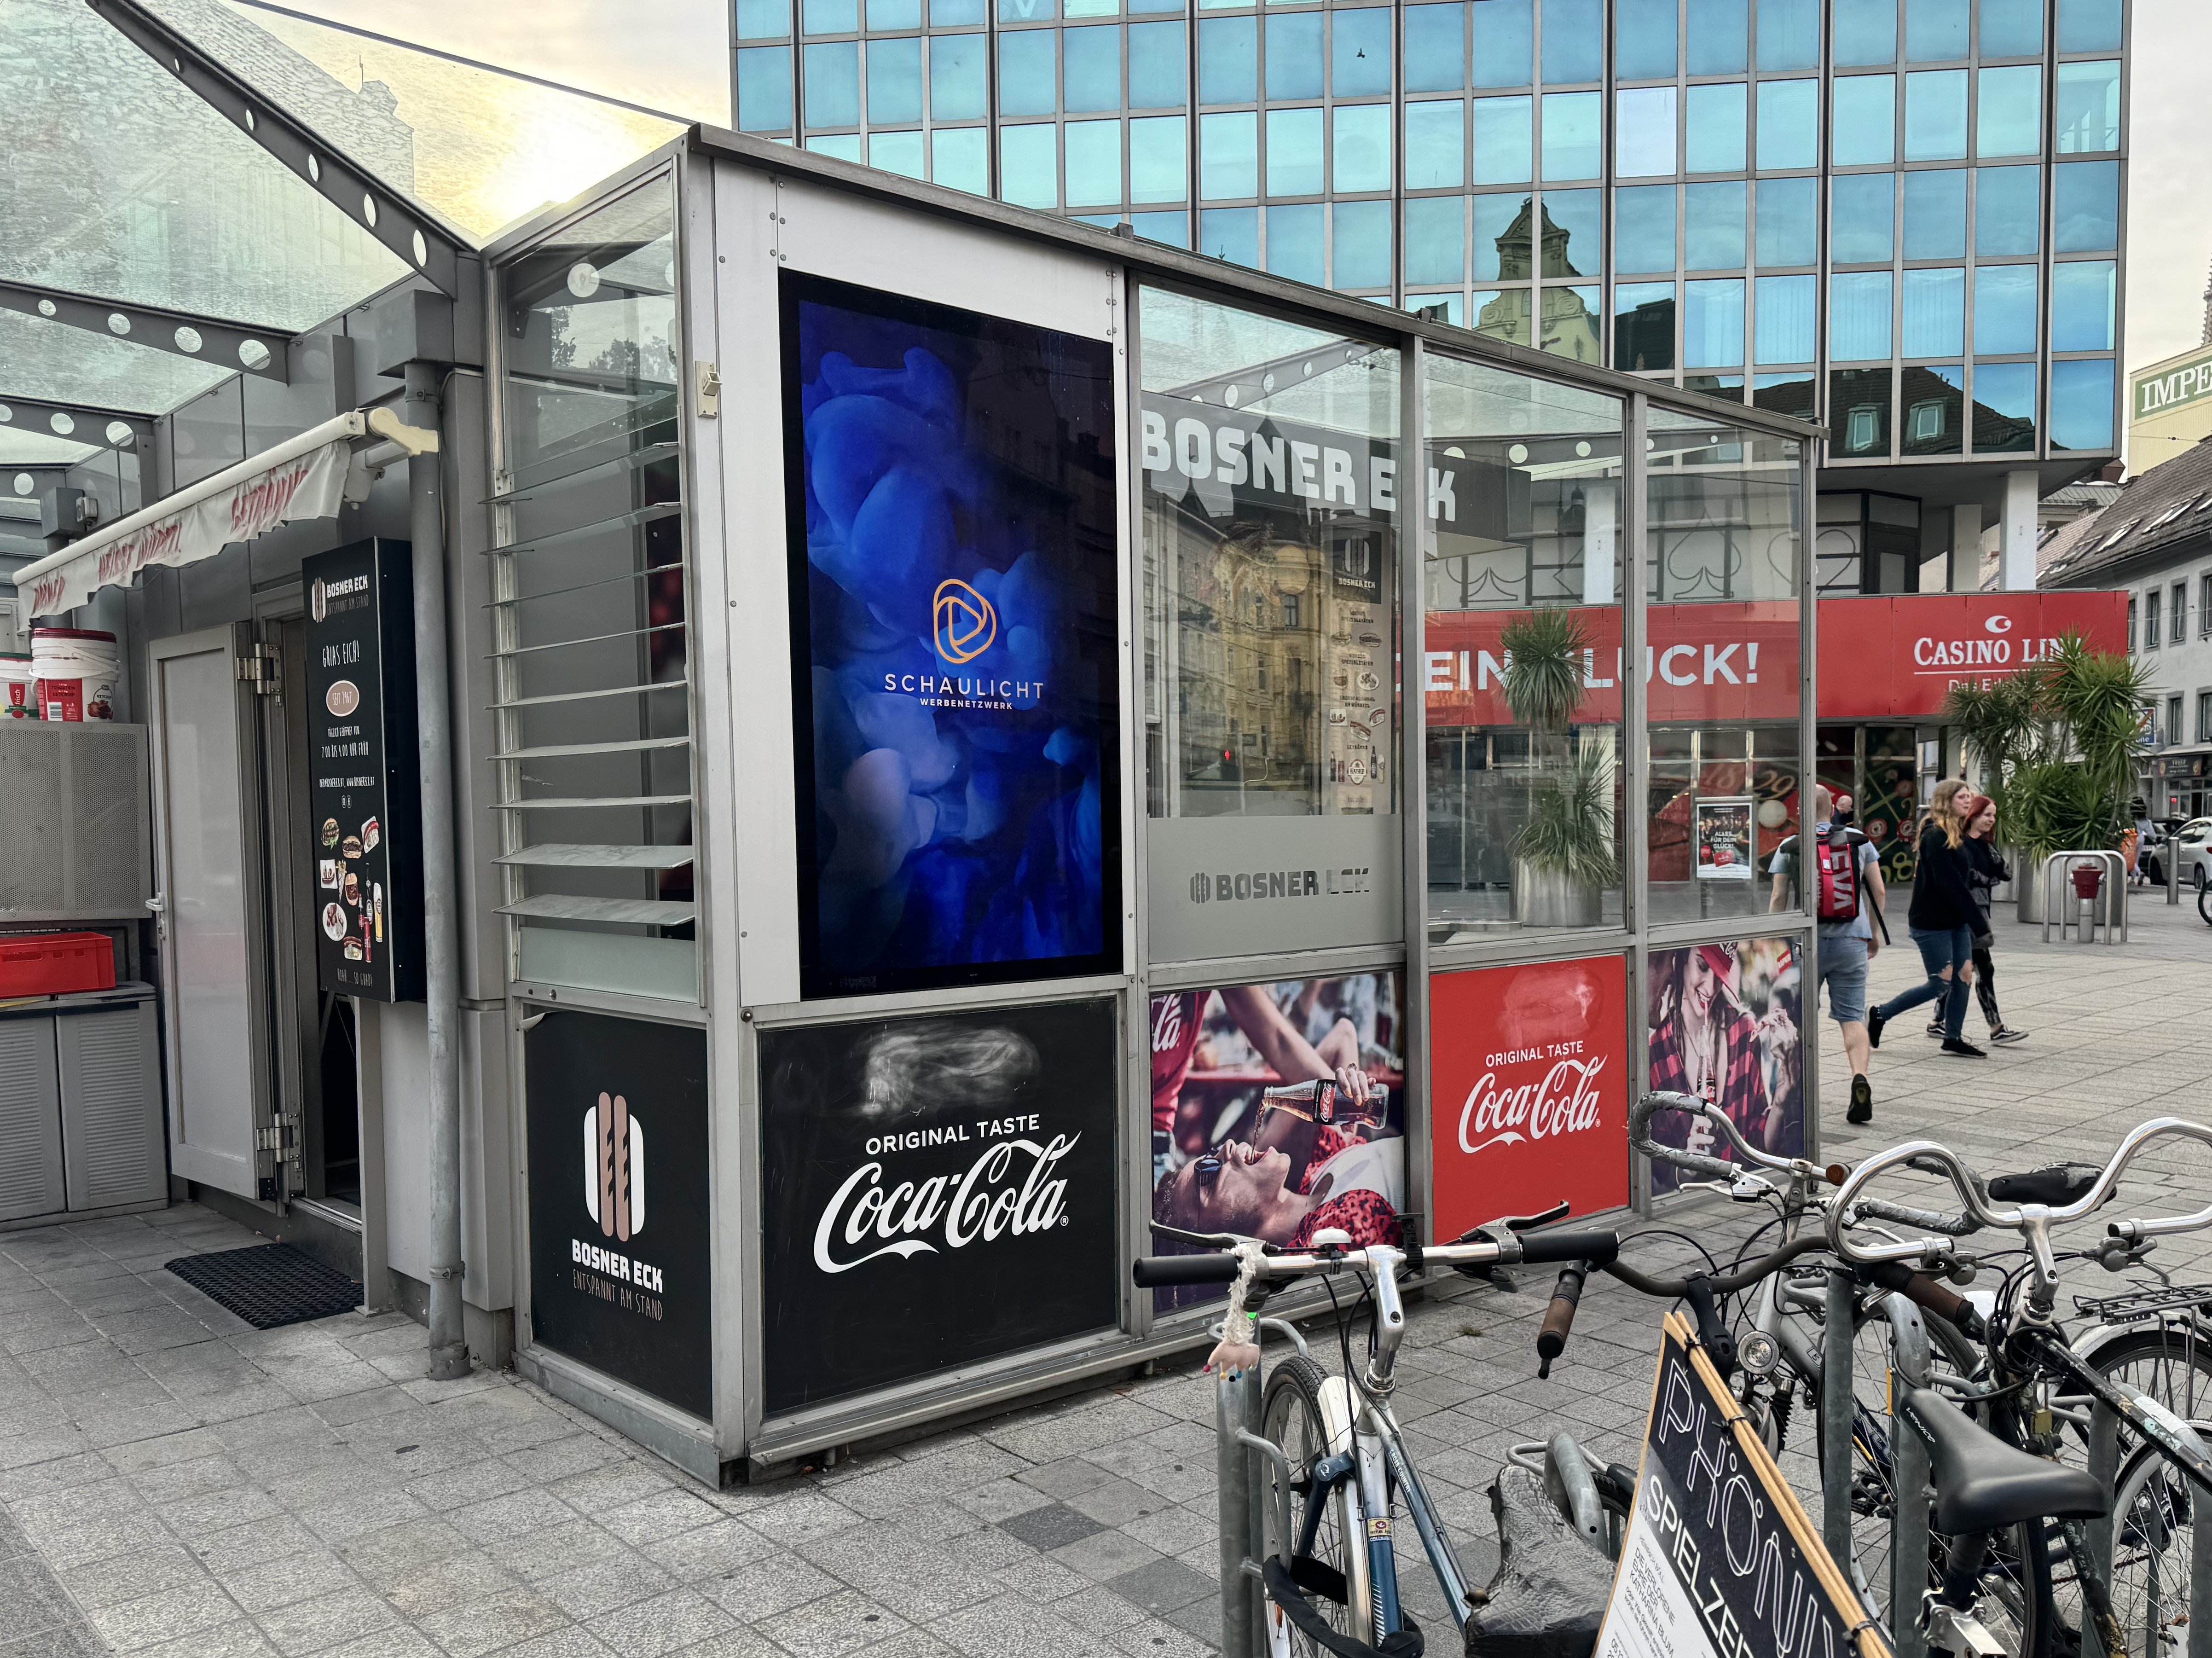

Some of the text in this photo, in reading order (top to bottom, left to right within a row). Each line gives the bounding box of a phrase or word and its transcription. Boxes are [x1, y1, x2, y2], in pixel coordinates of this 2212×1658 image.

[2141, 361, 2212, 412] IMPE
[1141, 410, 1456, 522] BOSNER EK
[327, 574, 368, 598] BOSNER ECK
[323, 640, 359, 667] GRIAS EICH!
[1396, 651, 1512, 691] EIN
[1914, 638, 2081, 666] CASINO LIN
[885, 673, 1044, 699] SCHAULICHT
[920, 698, 1013, 710] WERBENETZWERK
[1216, 871, 1319, 901] BOSNER
[1486, 1040, 1584, 1067] ORIGINAL TASTE
[1458, 1054, 1608, 1154] Coca-Cola
[866, 1114, 1040, 1154] ORIGINAL TASTE
[814, 1130, 1082, 1273] Coca-Cola
[572, 1239, 663, 1293] BOSNER ECK
[573, 1269, 663, 1321] ENTSPANNT AM STAND
[1632, 1558, 1658, 1610] EHRE DER
[1635, 1547, 1676, 1626] DIE VERLORENE
[1630, 1570, 1674, 1658] KATHARINA BLUM
